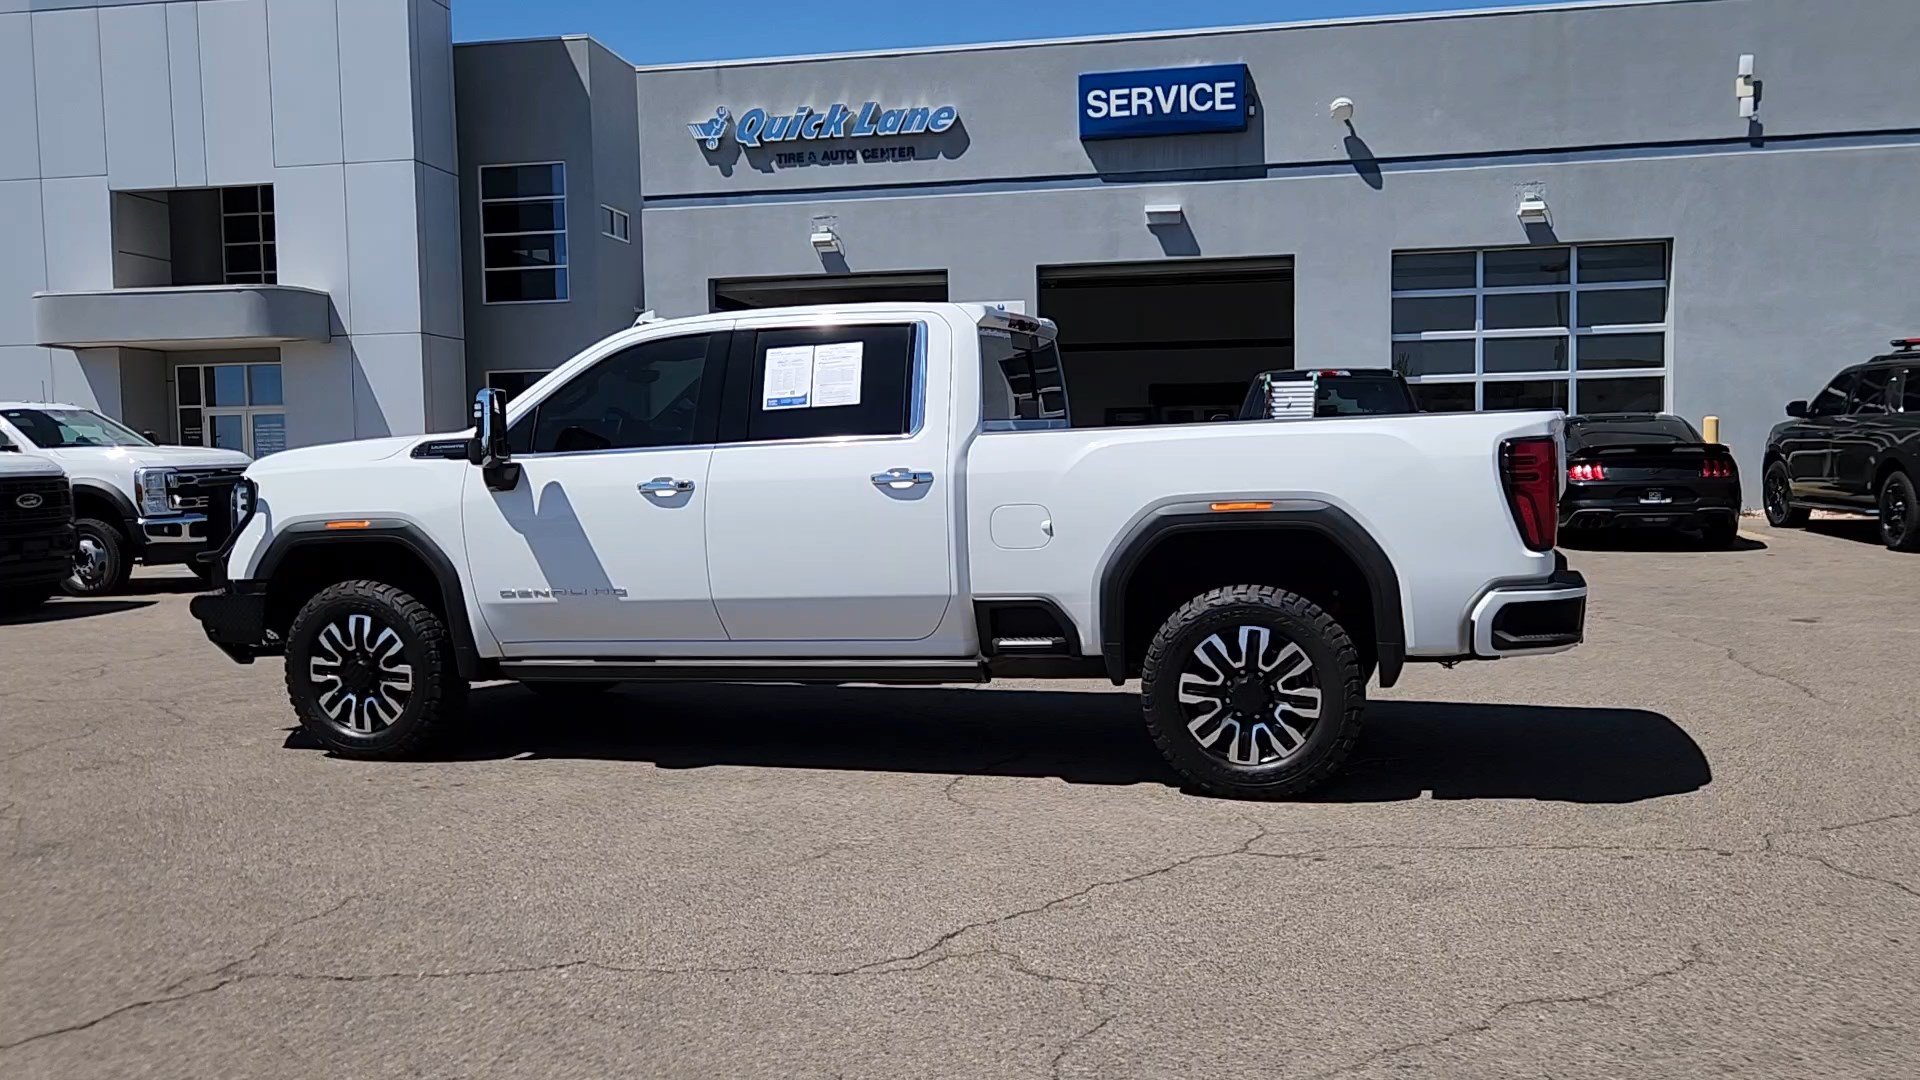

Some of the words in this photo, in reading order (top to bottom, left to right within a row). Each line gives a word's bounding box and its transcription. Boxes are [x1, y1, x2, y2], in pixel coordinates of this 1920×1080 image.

[1086, 81, 1237, 119] SERVICE
[734, 103, 853, 147] Quick
[850, 101, 958, 138] Lane
[776, 151, 804, 164] TIRE
[808, 152, 817, 162] &
[821, 149, 856, 162] AUTO
[861, 146, 916, 160] CENTER
